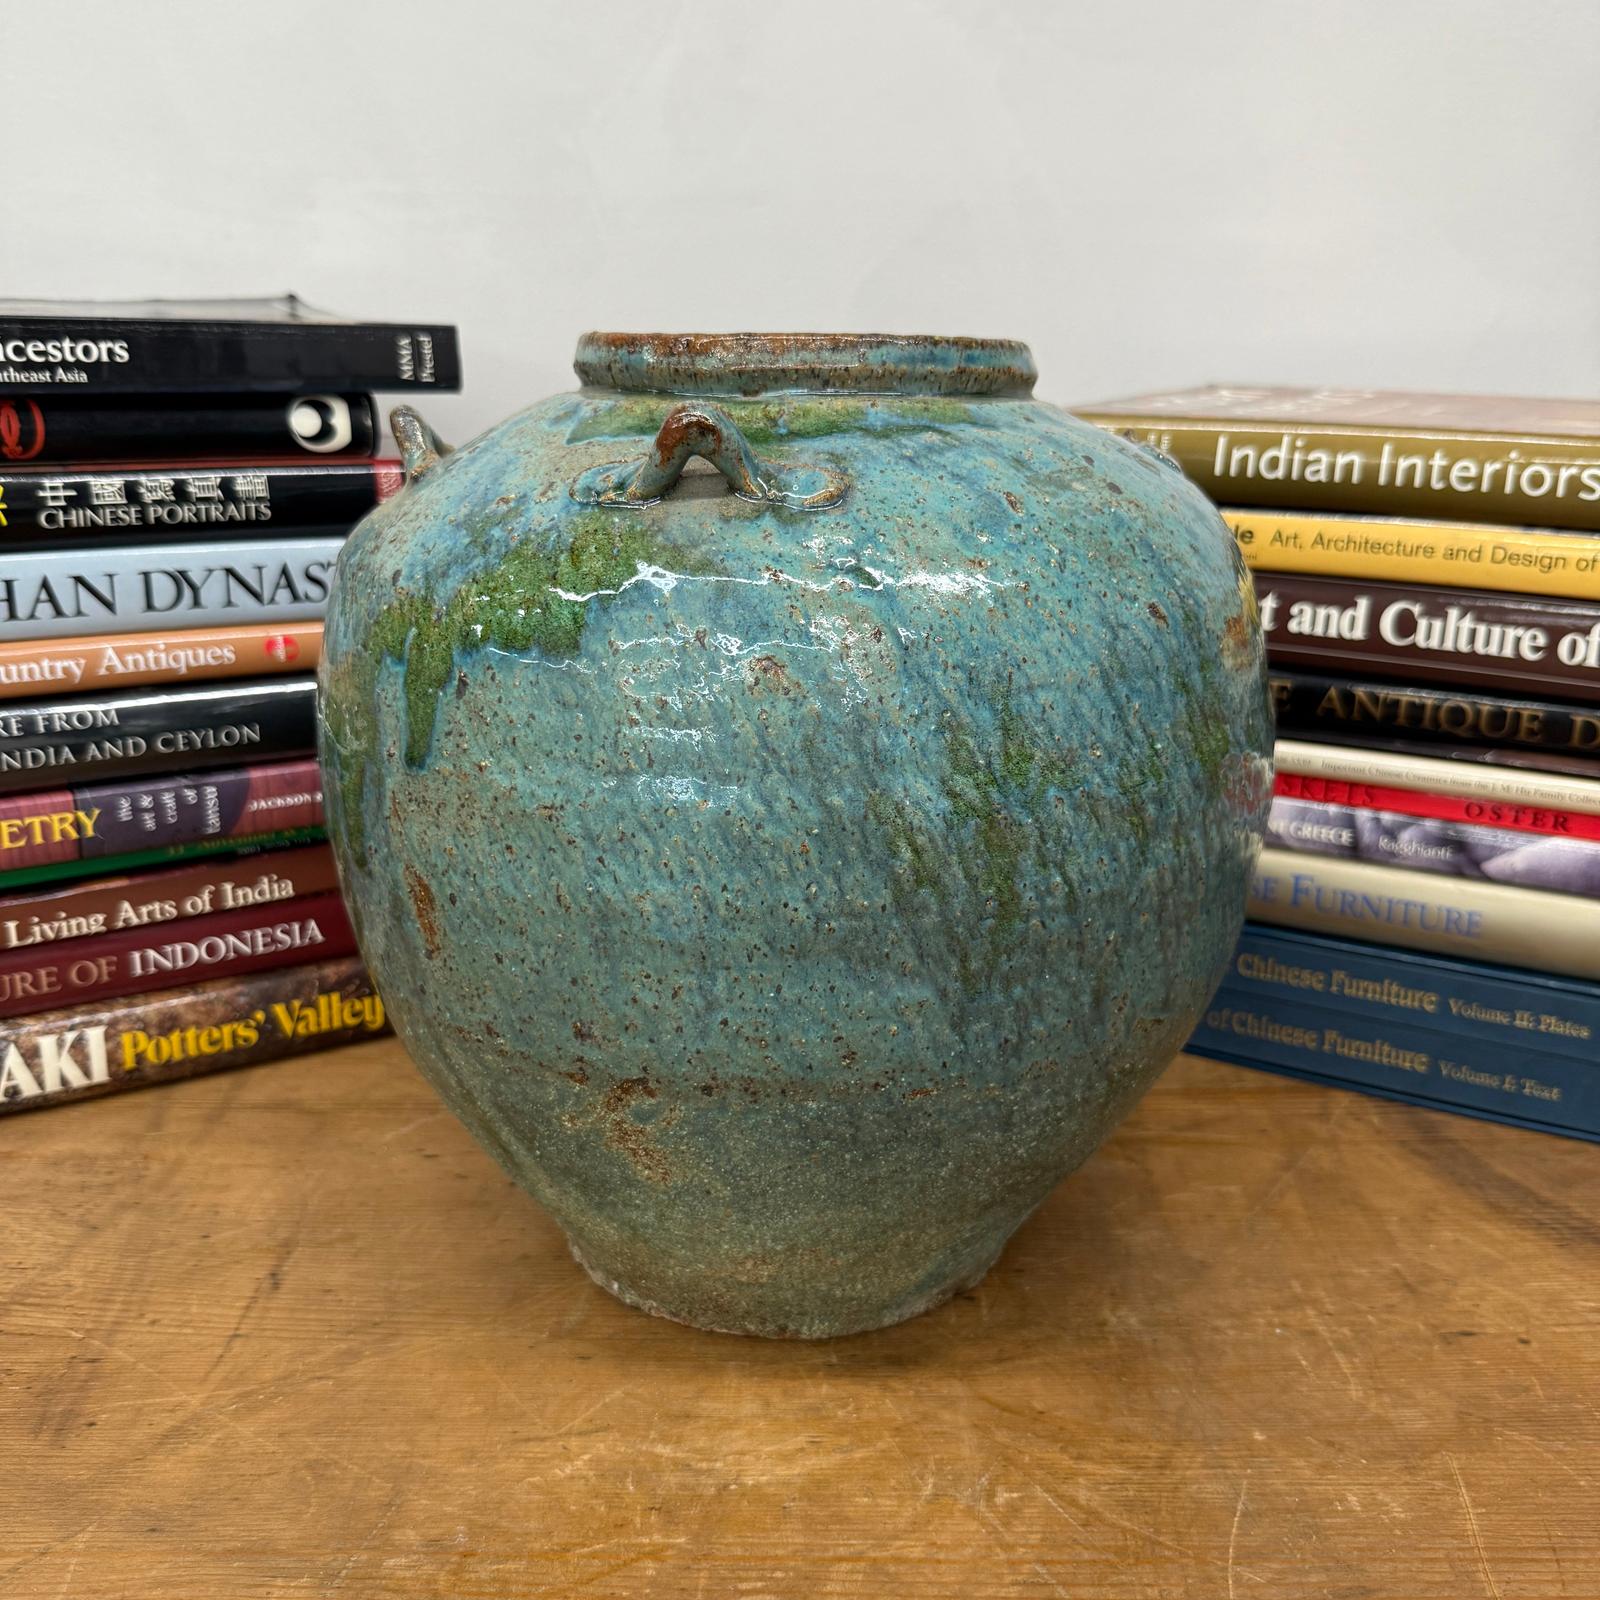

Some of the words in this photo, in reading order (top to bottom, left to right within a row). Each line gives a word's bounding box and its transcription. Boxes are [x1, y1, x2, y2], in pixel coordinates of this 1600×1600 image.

[0, 366, 52, 383] theast
[54, 366, 89, 383] Asia
[395, 333, 415, 380] MMA
[416, 331, 436, 383] Prestel
[1213, 433, 1363, 486] Indian
[1377, 442, 1600, 501] Interiors
[39, 504, 143, 529] CHINESE
[149, 500, 273, 524] PORTRAITS
[1311, 531, 1435, 559] Architecture
[1444, 540, 1482, 563] and
[1490, 546, 1567, 574] Design
[1575, 554, 1600, 572] of
[139, 562, 337, 614] DYNAS
[1287, 594, 1370, 641] and
[1379, 600, 1549, 662] Culture
[1557, 622, 1600, 669] of
[98, 642, 237, 675] Antiques
[33, 707, 120, 734] FROM
[1315, 685, 1545, 741] ANTIQUE
[82, 736, 147, 762] AND
[156, 722, 262, 754] CEYLON
[247, 792, 312, 813] JACKSON
[1289, 820, 1355, 848] GREECE
[4, 911, 108, 949] Living
[115, 900, 178, 929] Arts
[183, 884, 216, 915] of
[220, 873, 296, 911] India
[1290, 872, 1483, 938] FURNITURE
[68, 955, 118, 988] OF
[128, 917, 326, 978] INDONESIA
[1236, 952, 1327, 992] Chinese
[1329, 969, 1440, 1015] Furniture
[1448, 997, 1511, 1026] Volume
[1538, 1013, 1592, 1039] Plates
[0, 1024, 113, 1101] AKI
[272, 992, 385, 1040] Valley
[1206, 1006, 1232, 1032] of
[1232, 1011, 1319, 1050] Chinese
[1322, 1028, 1432, 1074] Furniture
[1438, 1059, 1500, 1089] Volume
[1519, 1077, 1562, 1101] Text
